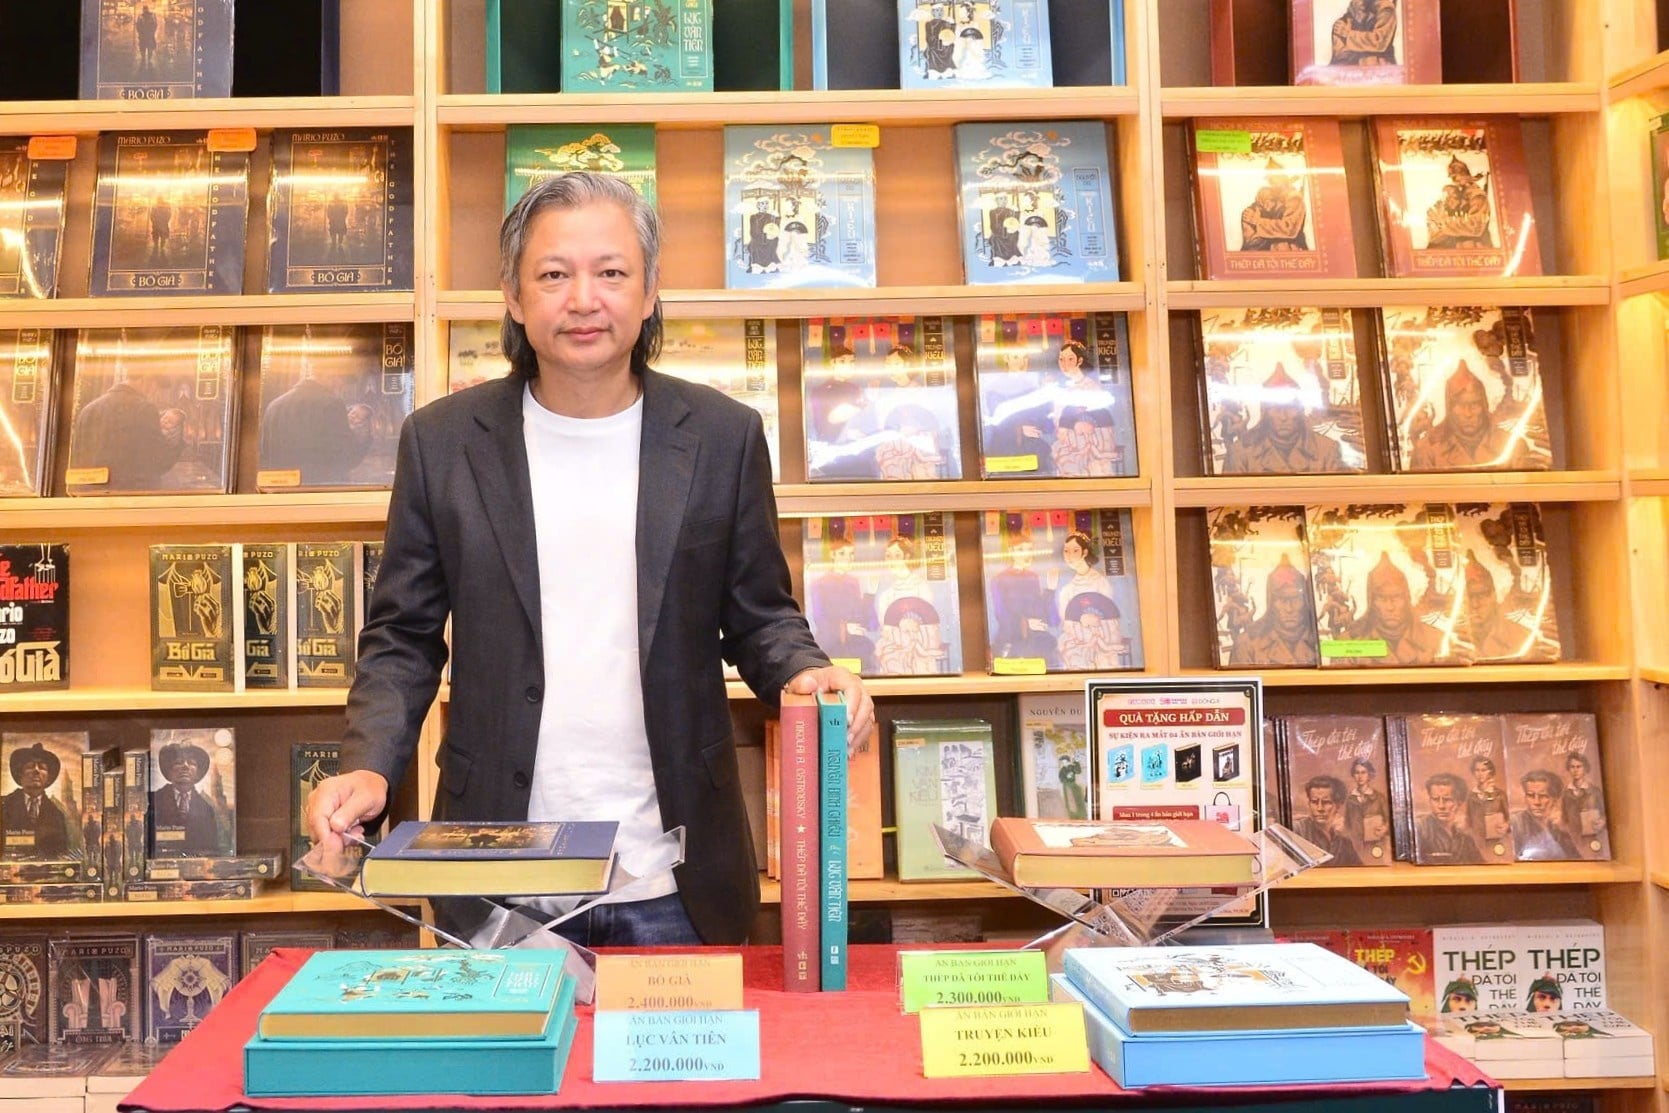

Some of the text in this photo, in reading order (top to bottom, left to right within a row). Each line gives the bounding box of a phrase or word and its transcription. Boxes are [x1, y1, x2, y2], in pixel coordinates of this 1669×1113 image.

[1119, 709, 1230, 725] QUÀ TẶNG HẤP DẪN
[1443, 944, 1516, 971] THÉP
[1527, 942, 1601, 970] THÉP
[626, 1030, 727, 1048] LỤC VÂN TIÊN
